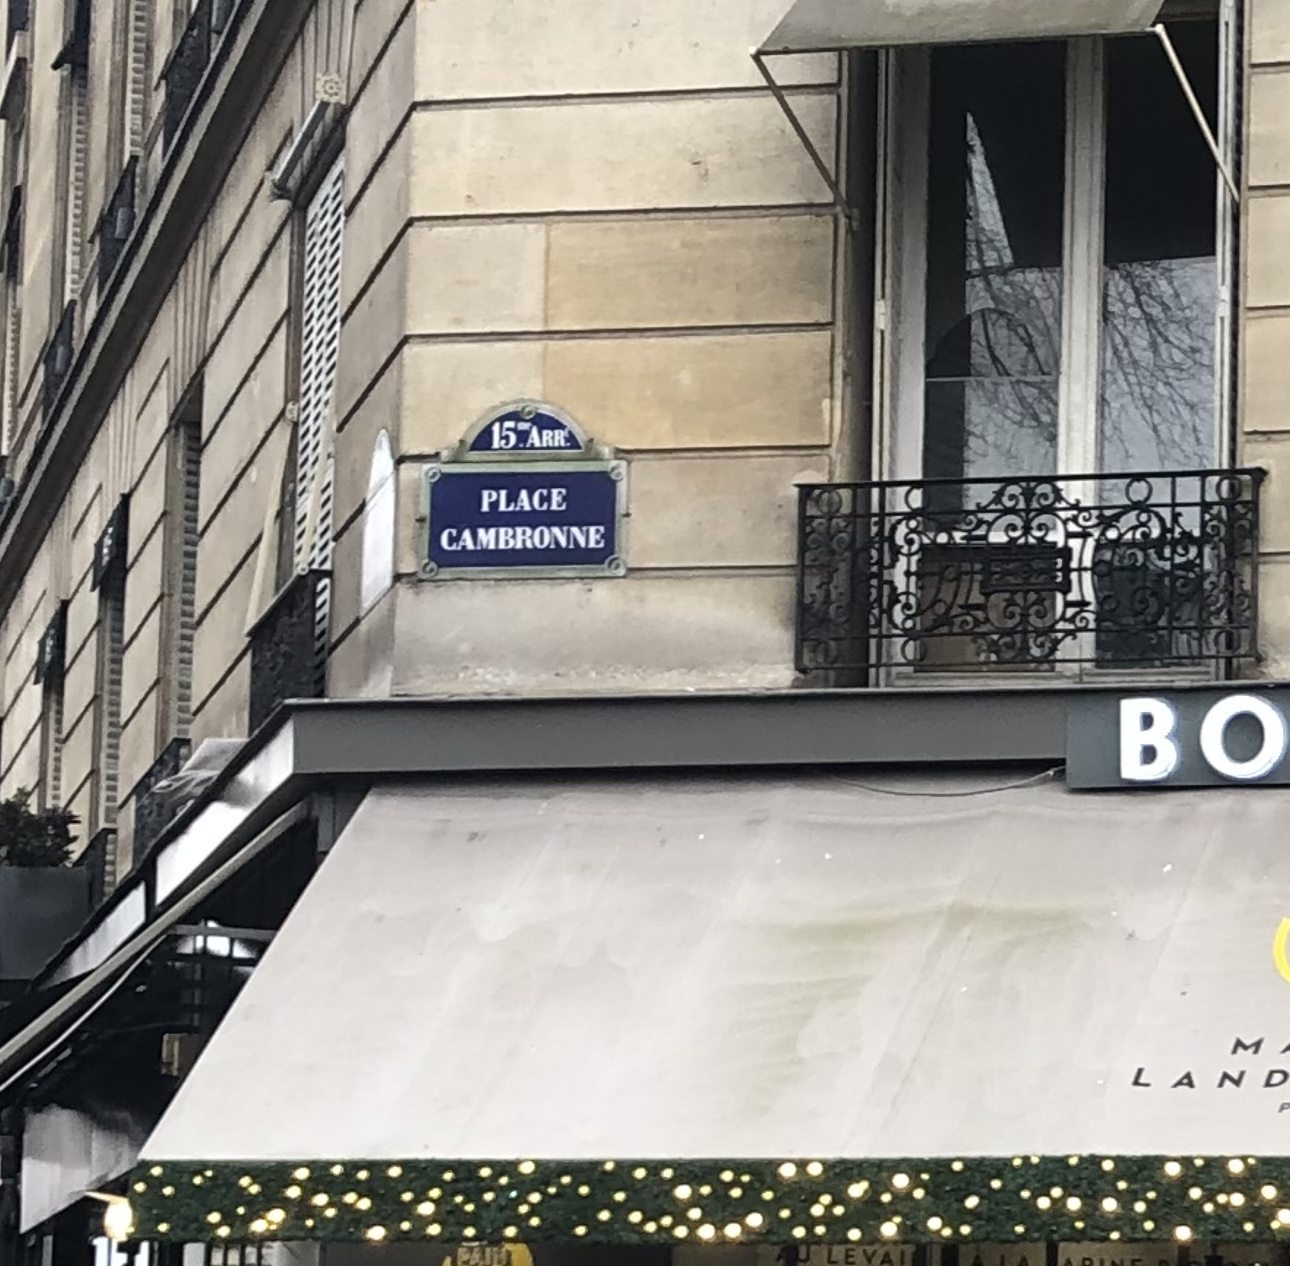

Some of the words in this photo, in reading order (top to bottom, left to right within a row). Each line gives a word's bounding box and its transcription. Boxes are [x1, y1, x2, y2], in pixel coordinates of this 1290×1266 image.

[480, 488, 567, 512] PLACE
[440, 525, 605, 551] CAMBRONNE
[827, 1247, 918, 1266] LEVAI
